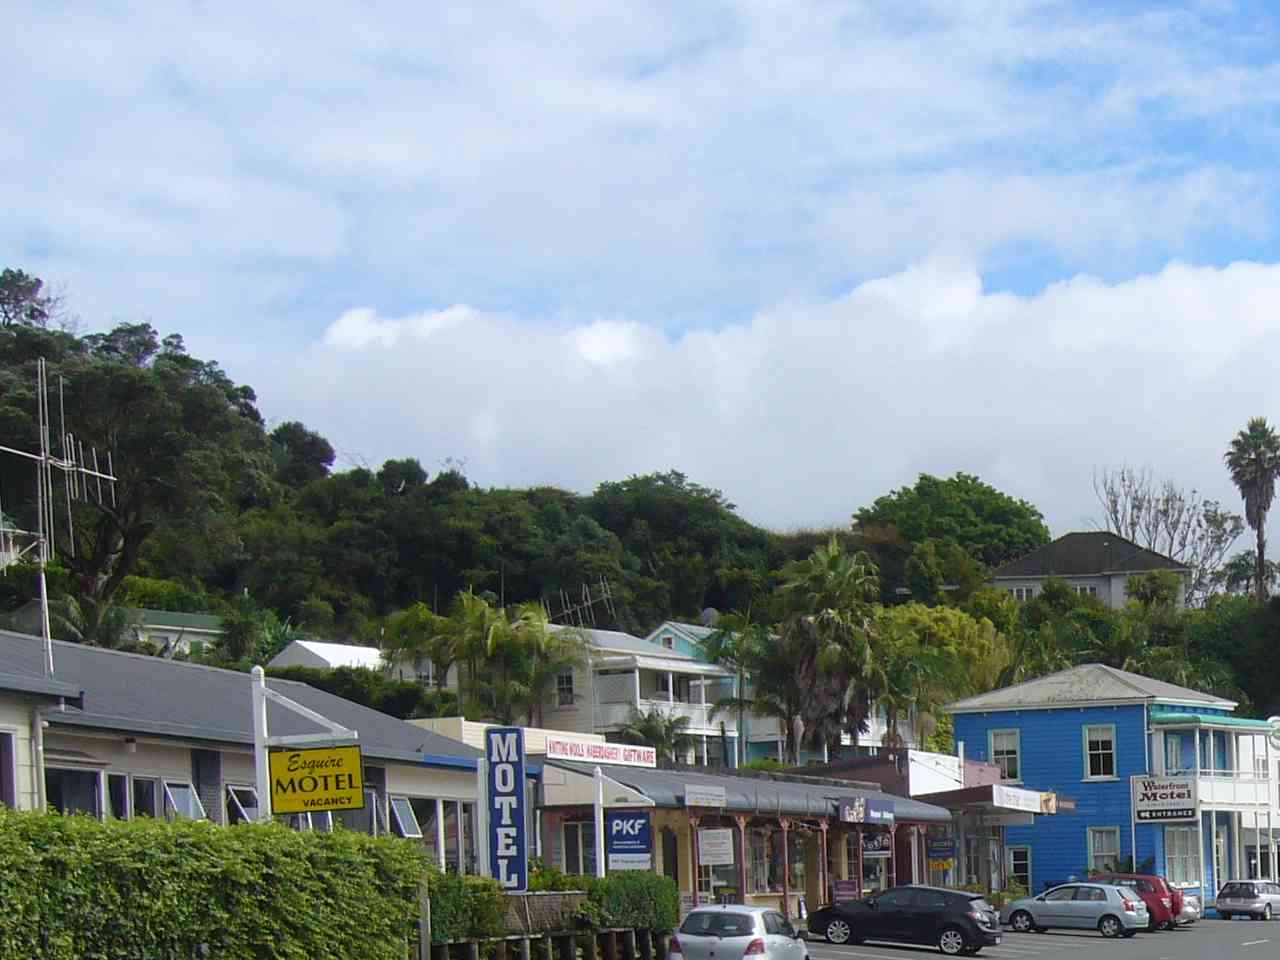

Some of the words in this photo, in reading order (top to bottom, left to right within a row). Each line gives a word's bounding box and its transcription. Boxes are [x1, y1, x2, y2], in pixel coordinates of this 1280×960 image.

[287, 754, 344, 774] Esquire
[623, 748, 655, 764] GIFTWARE
[274, 774, 361, 795] MOTEL
[1142, 780, 1189, 791] Waterfront
[302, 796, 353, 807] VACANCY
[1139, 790, 1192, 801] Motel
[490, 733, 519, 888] MOTEL
[1152, 810, 1193, 818] ENTRANCE
[612, 819, 646, 835] PKF
